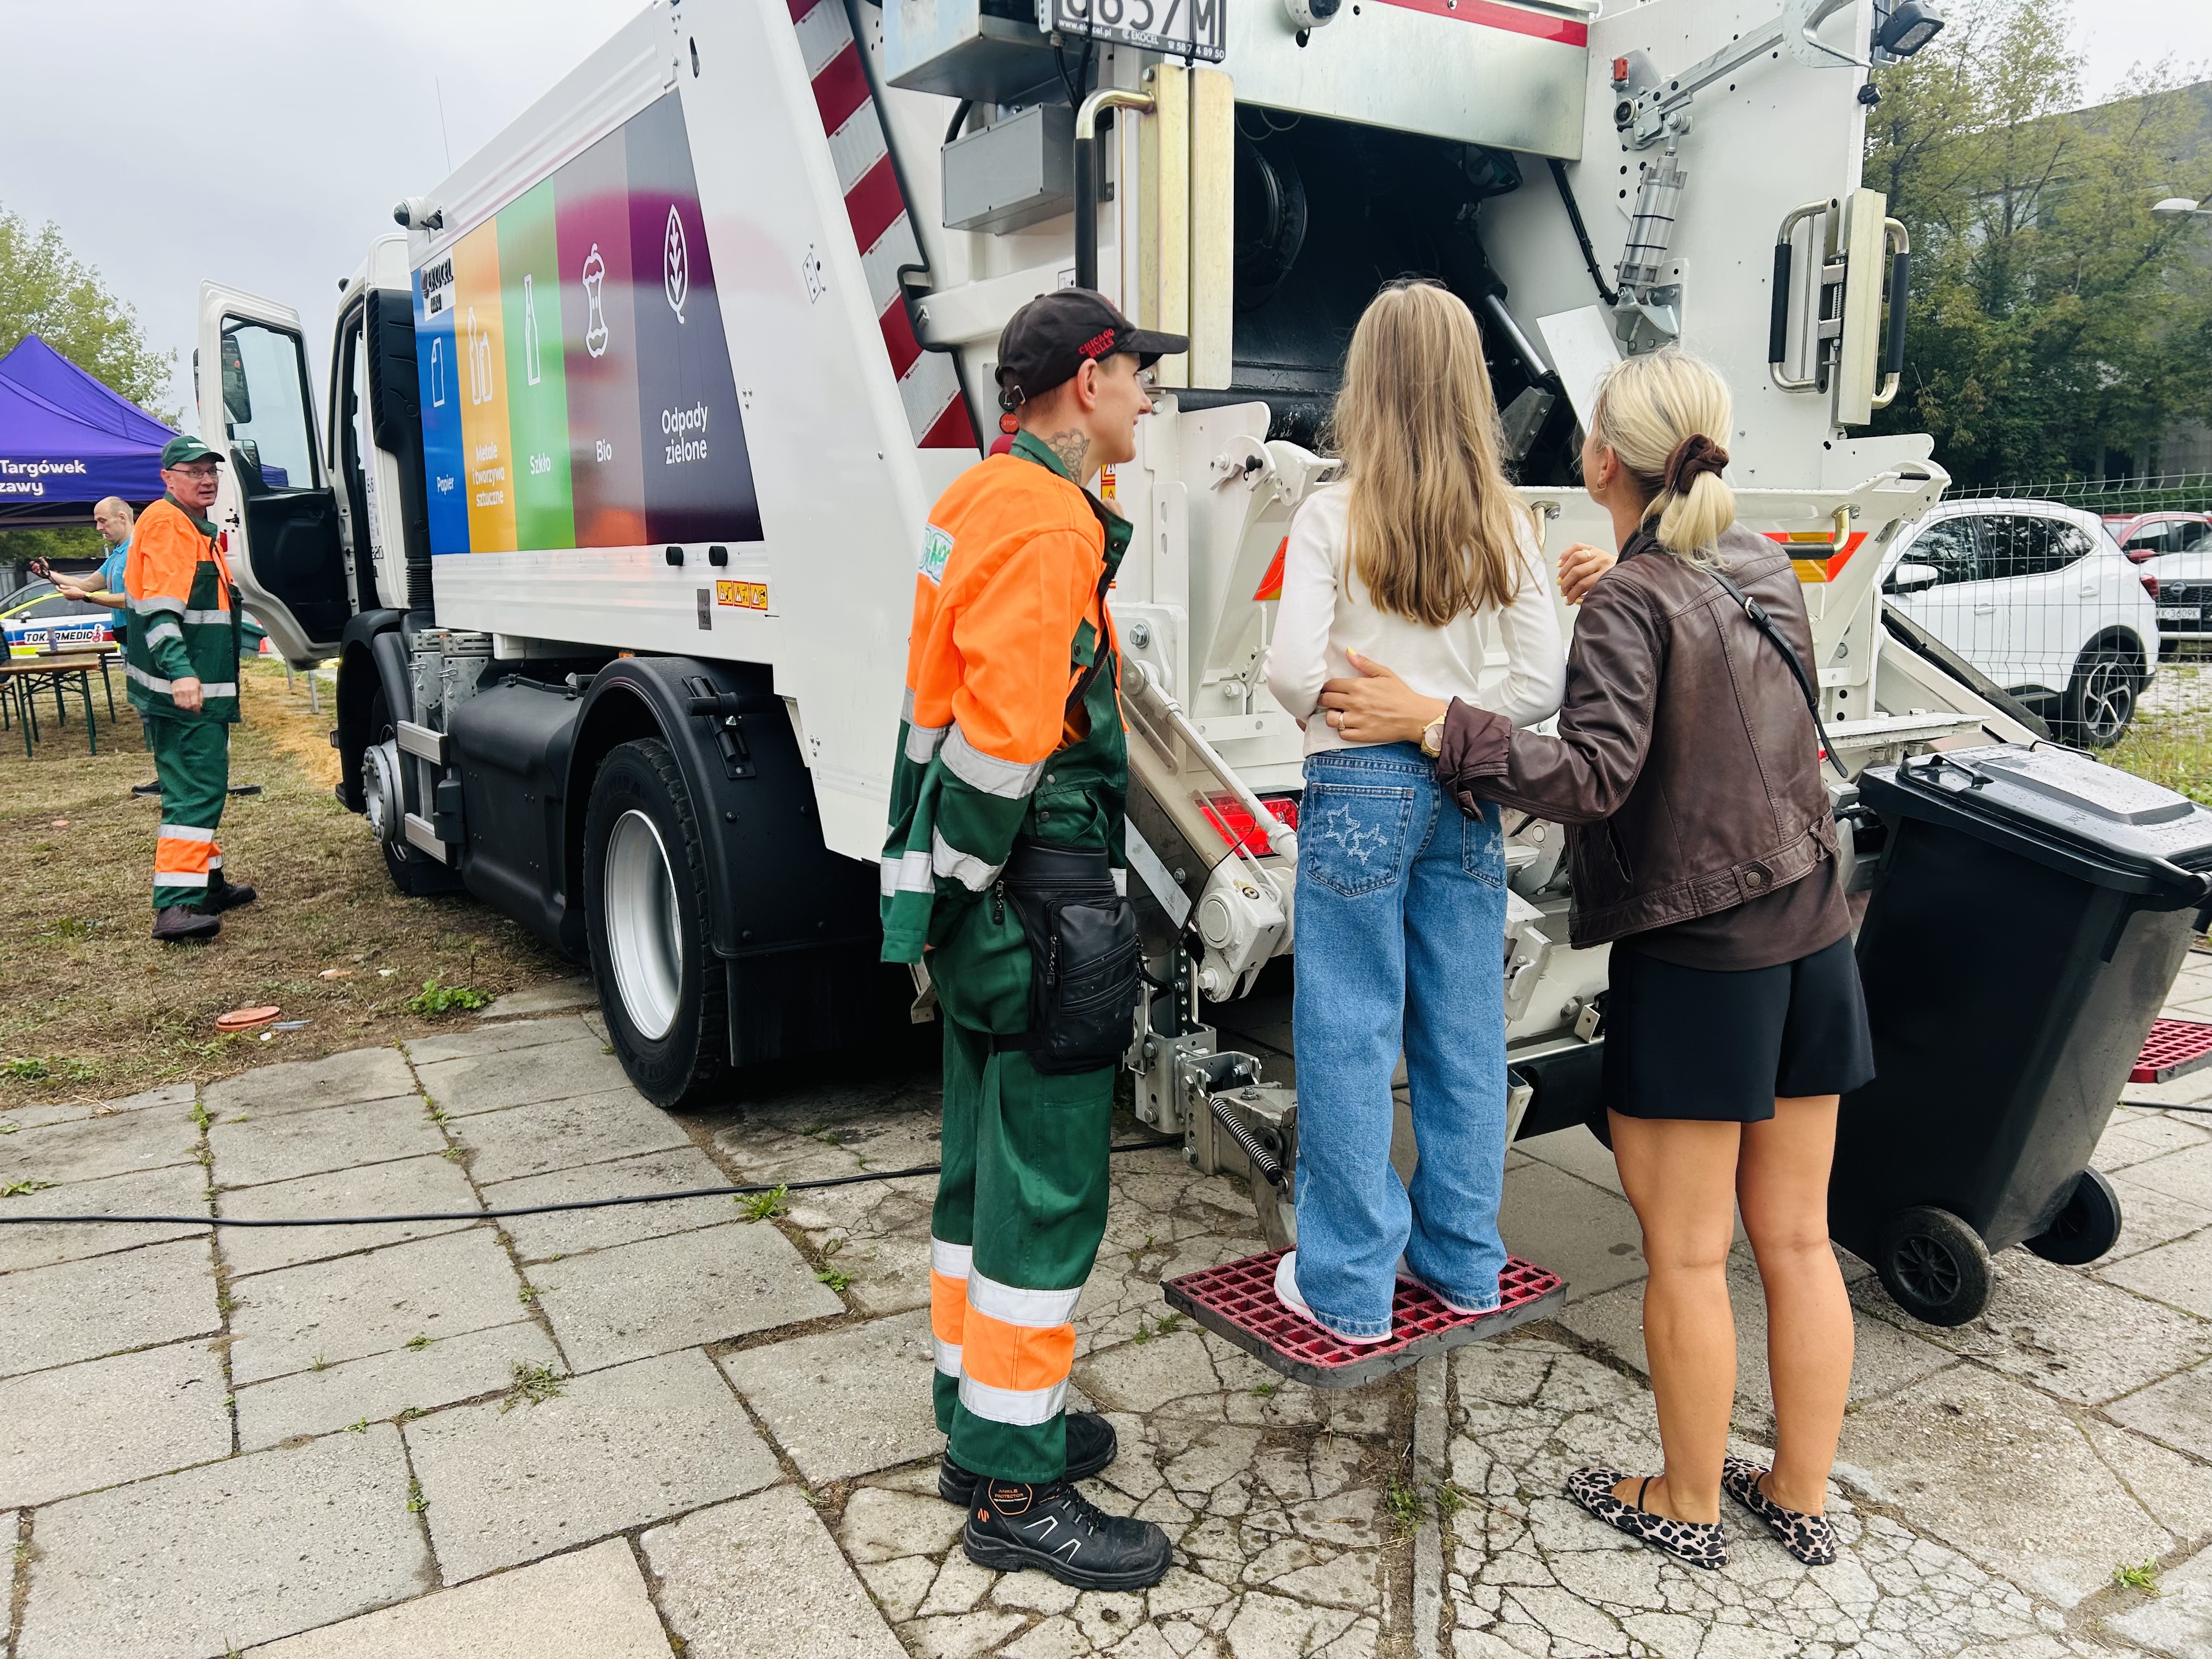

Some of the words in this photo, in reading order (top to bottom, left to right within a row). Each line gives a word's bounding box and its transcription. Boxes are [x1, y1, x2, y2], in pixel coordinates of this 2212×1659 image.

[1058, 19, 1111, 38] www.ekcel.pl
[1131, 31, 1159, 45] EKOCEL
[1176, 41, 1186, 52] 58
[1188, 43, 1201, 54] 74
[1215, 49, 1224, 58] 50
[1079, 328, 1115, 354] CHICAGO
[1088, 337, 1114, 358] BULLS
[662, 400, 708, 437] Odpady
[476, 441, 498, 462] Metale
[596, 438, 612, 462] Bio
[665, 437, 707, 465] zielone
[0, 459, 86, 477] Targówek
[530, 452, 551, 475] Szkło
[437, 473, 454, 495] Papier
[475, 466, 505, 487] tworzywa
[476, 490, 504, 507] sztuczne
[26, 631, 93, 642] TOKRMEDIC
